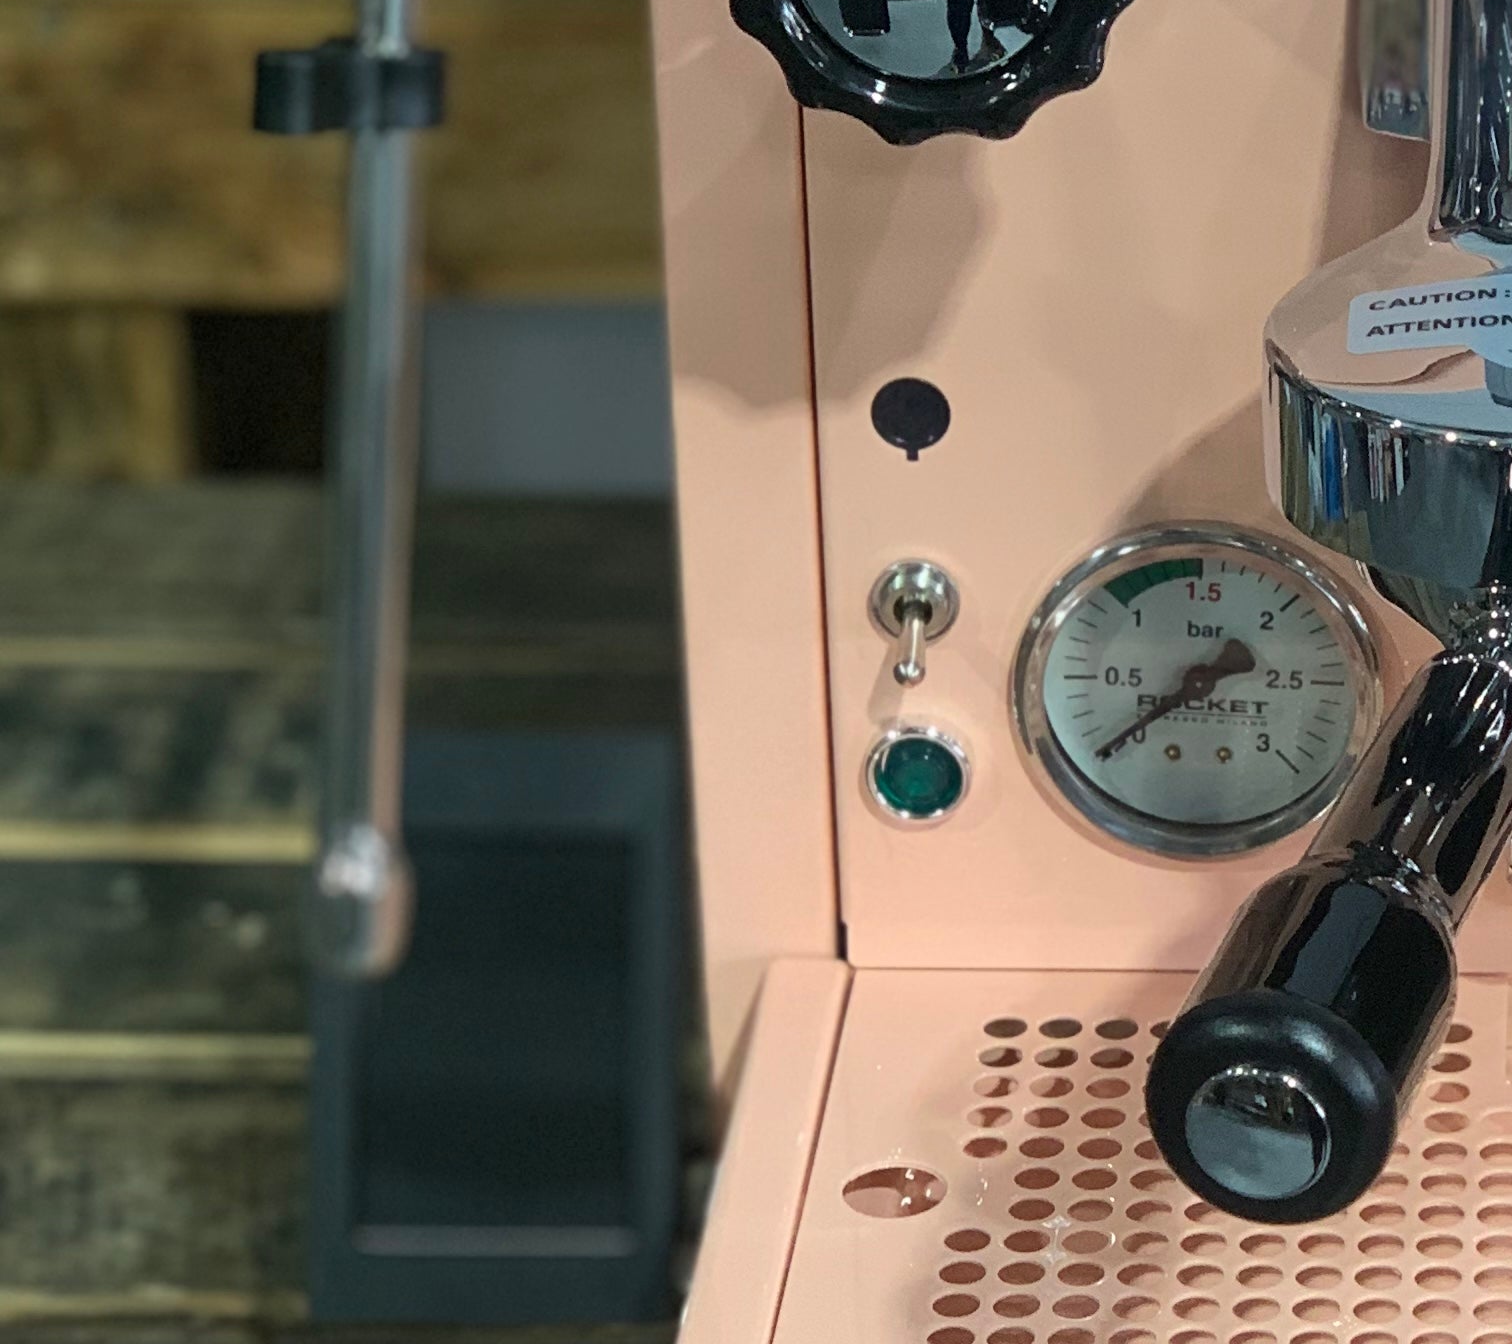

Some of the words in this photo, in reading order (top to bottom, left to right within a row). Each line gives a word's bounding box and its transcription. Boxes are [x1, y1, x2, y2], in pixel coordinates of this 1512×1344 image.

[1368, 287, 1497, 311] CAUTION
[1185, 582, 1222, 602] 1.5
[1132, 609, 1143, 628] 1
[1260, 611, 1275, 630] 2
[1187, 620, 1224, 639] bar
[1104, 666, 1143, 687] 0.5
[1265, 670, 1304, 690] 2.5
[1256, 733, 1271, 752] 3
